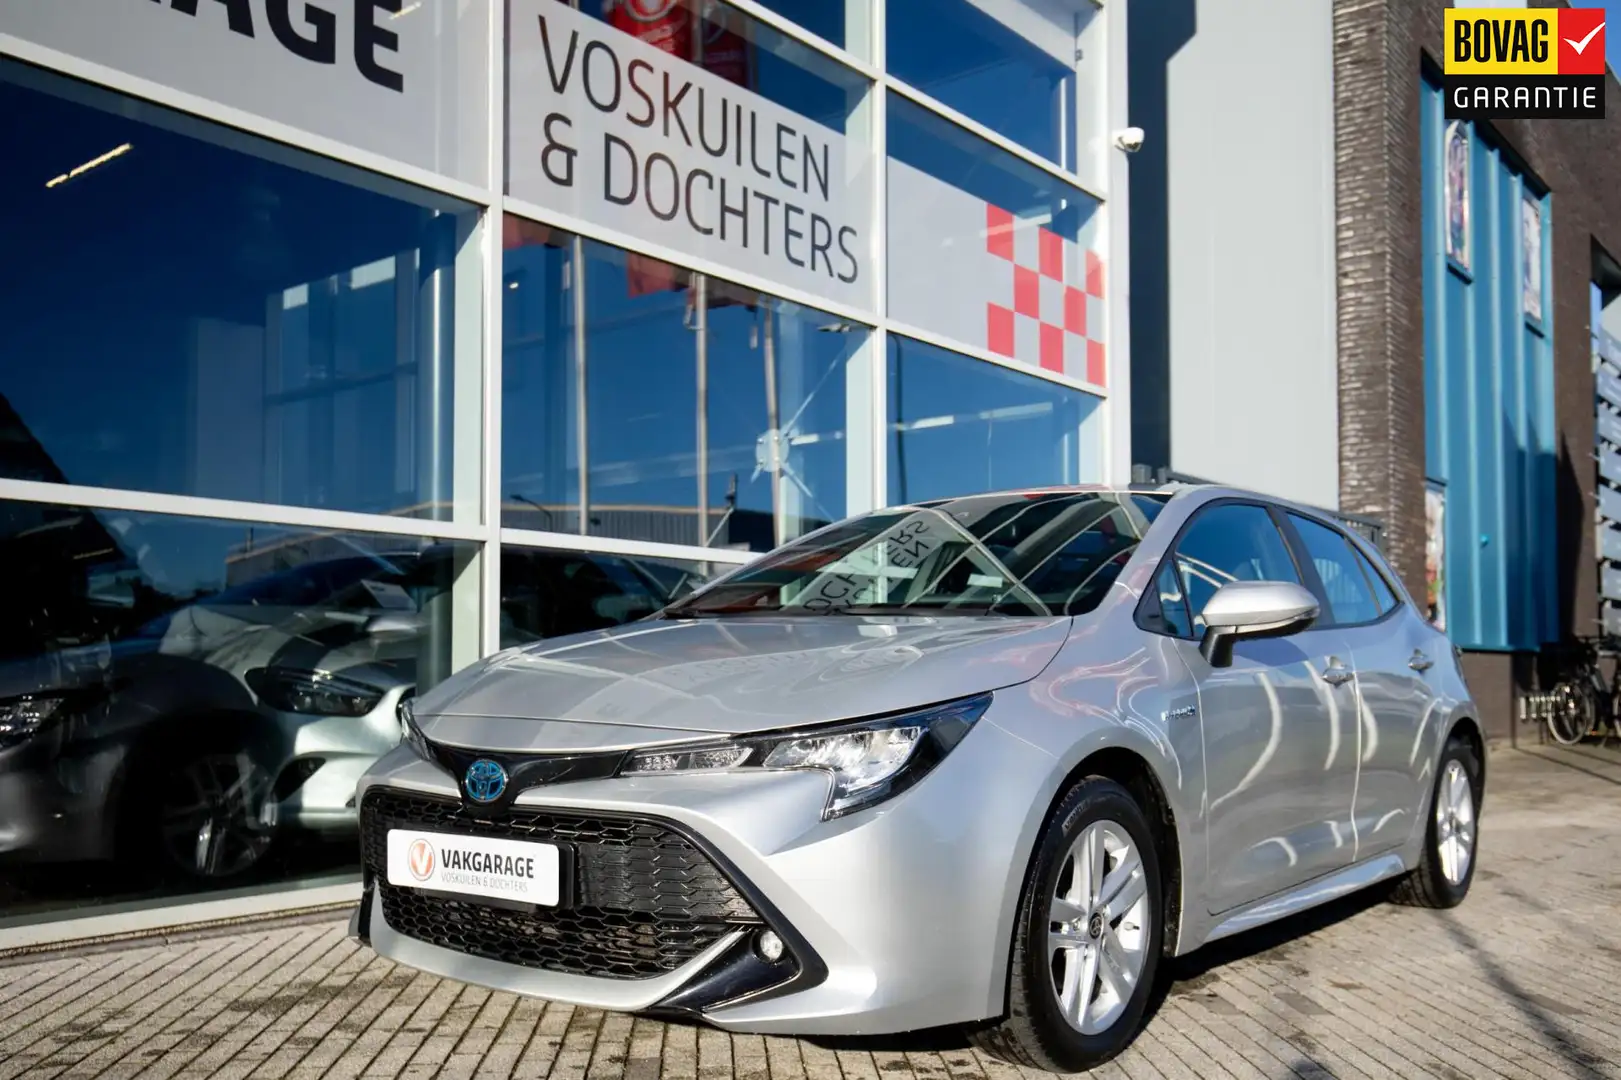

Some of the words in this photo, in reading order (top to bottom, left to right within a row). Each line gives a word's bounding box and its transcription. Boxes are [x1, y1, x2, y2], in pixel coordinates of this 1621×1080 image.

[538, 14, 829, 202] VOSKUILEN
[541, 112, 578, 187] &
[604, 132, 858, 284] DOCHTERS
[441, 848, 534, 879] VAKGARAGE
[441, 872, 481, 885] VOSKUILEN
[483, 875, 488, 887] &
[490, 877, 528, 892] DOCHTERS
